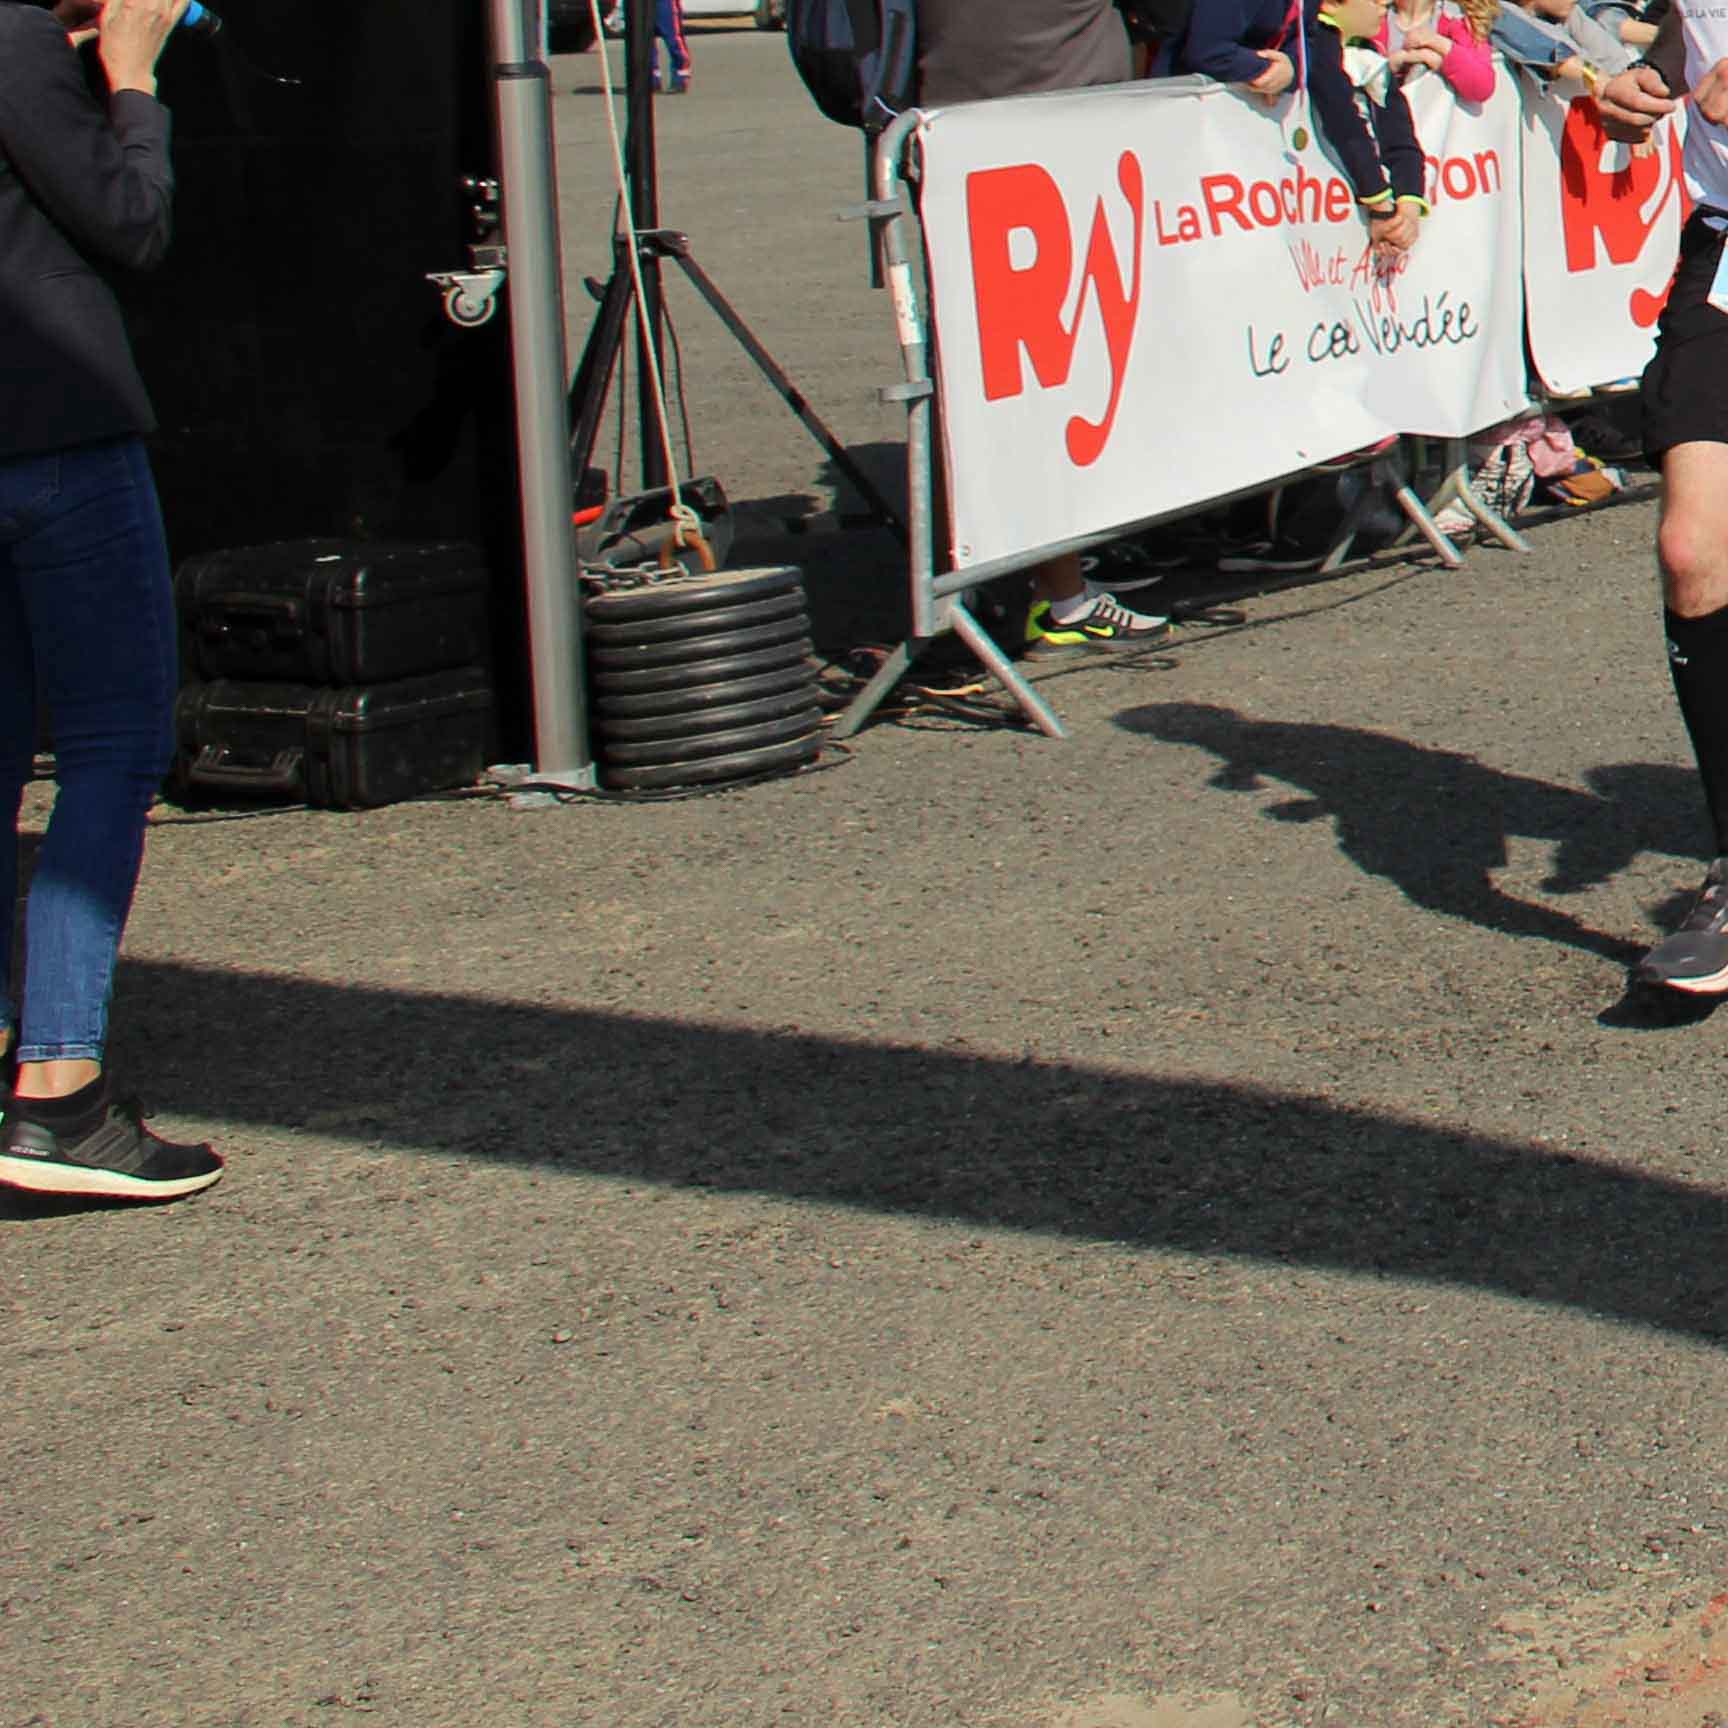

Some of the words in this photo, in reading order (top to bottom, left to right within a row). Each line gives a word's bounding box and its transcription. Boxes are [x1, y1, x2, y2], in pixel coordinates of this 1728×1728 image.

[1152, 199, 1201, 246] La
[1247, 324, 1291, 377] Le
[1352, 290, 1479, 356] Vendée
